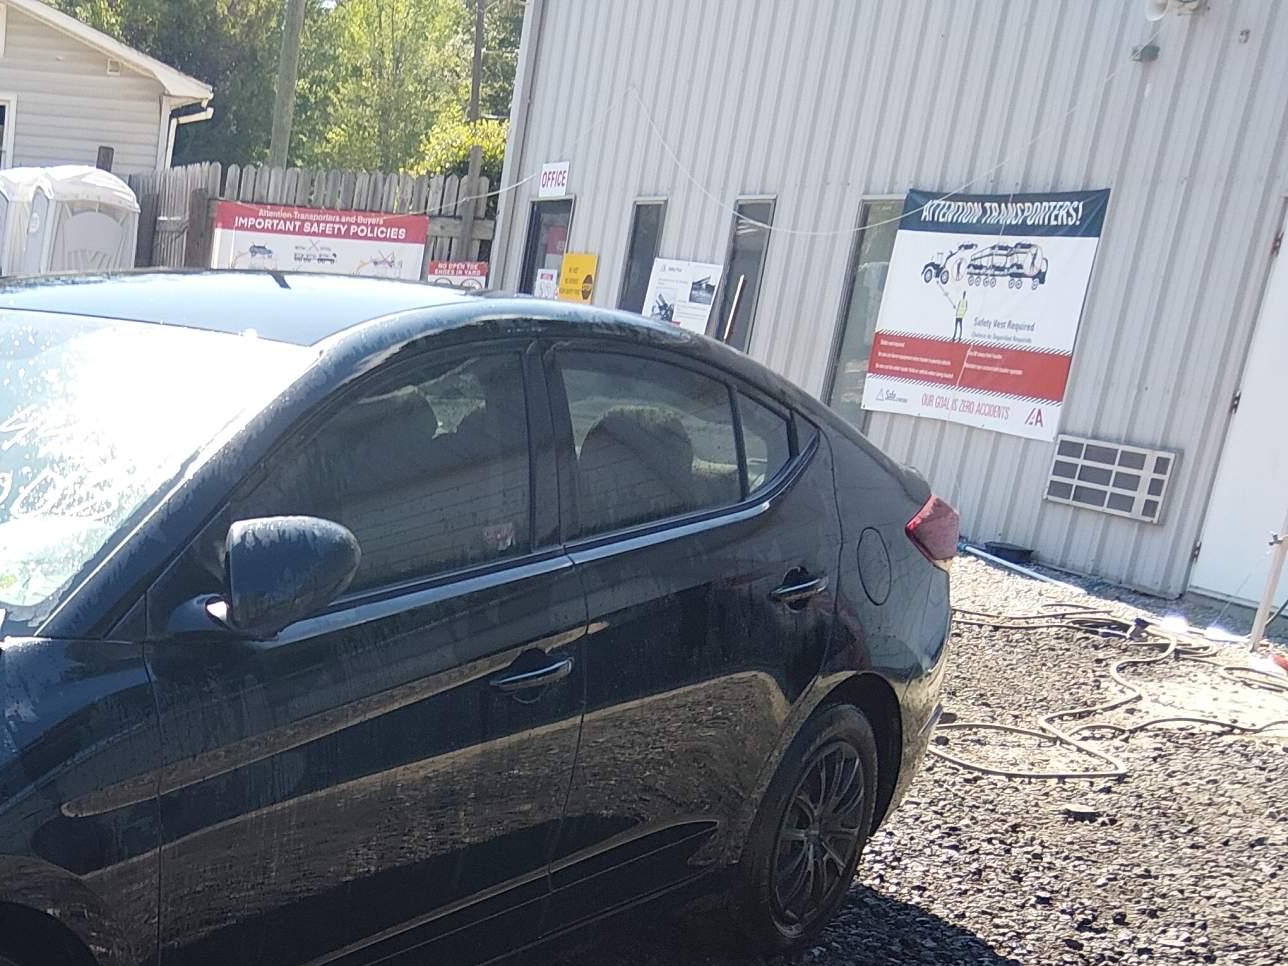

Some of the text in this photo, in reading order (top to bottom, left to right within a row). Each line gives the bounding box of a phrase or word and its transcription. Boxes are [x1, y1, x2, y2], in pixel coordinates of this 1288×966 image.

[541, 170, 568, 188] OFFICE
[258, 208, 385, 226] Attention Transporters and Buyers
[921, 199, 1084, 226] ATTENTION TRANSPORTERS!
[234, 215, 407, 239] IMPORTANT SAFETY POLICIES
[973, 316, 1036, 333] Safety Vest Required
[885, 389, 897, 400] Safe
[921, 392, 935, 407] OUR
[934, 395, 950, 410] GOAL
[950, 398, 959, 412] IS
[958, 399, 975, 415] ZERO
[975, 400, 1011, 421] ACCIDENTS
